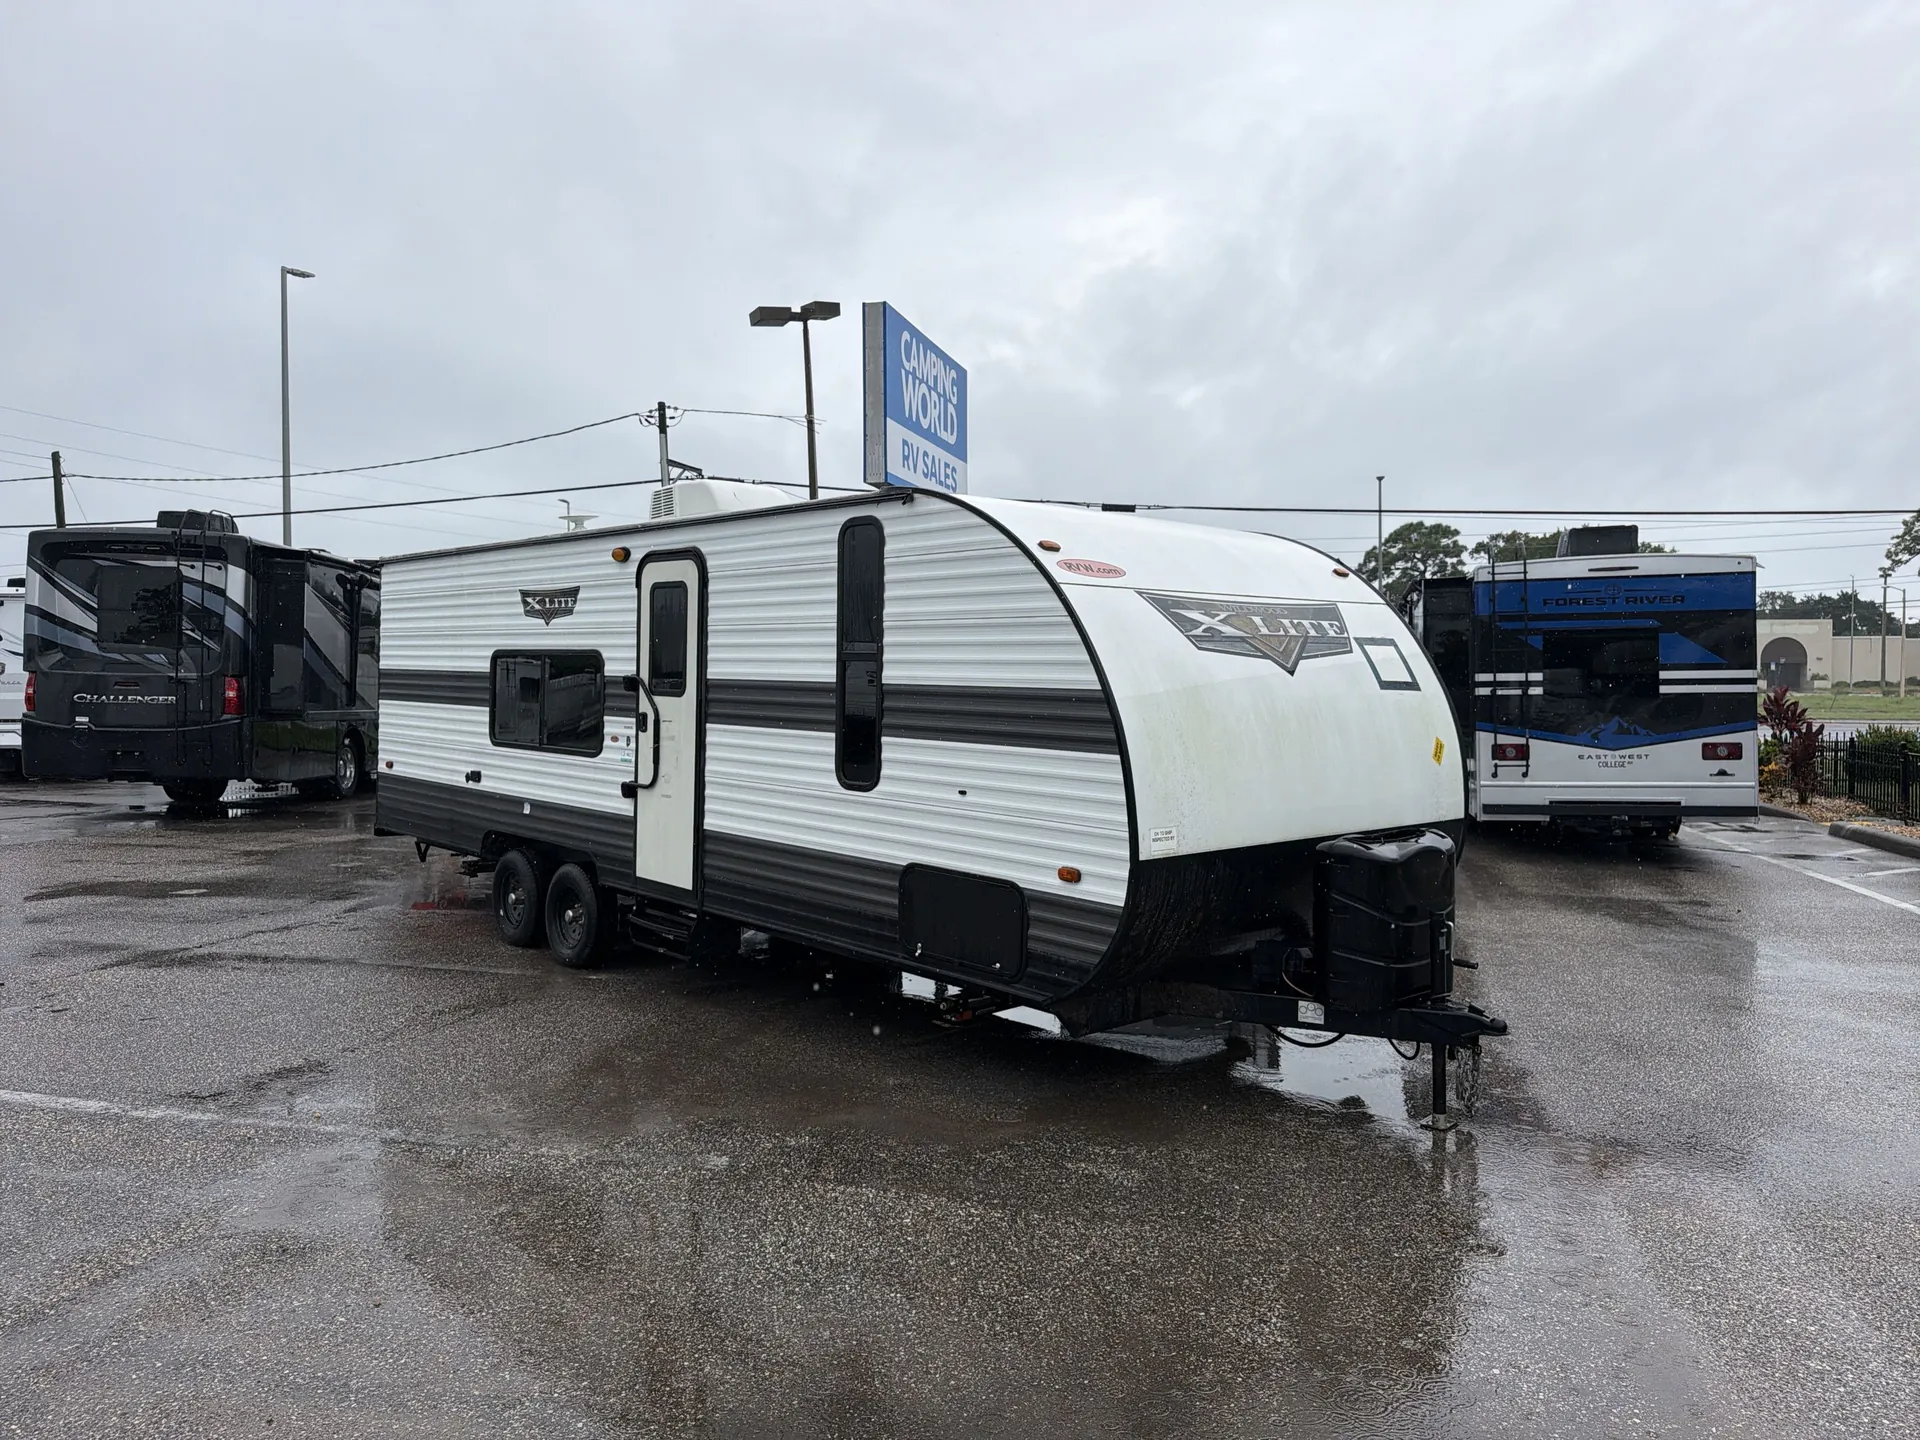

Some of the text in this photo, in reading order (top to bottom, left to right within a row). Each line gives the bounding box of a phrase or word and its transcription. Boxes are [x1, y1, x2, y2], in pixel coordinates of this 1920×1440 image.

[901, 330, 957, 405] CAMPING
[901, 368, 957, 445] WORLD
[902, 437, 957, 493] RV SALES
[524, 596, 576, 610] X LITE
[1542, 594, 1686, 607] FOREST RIVER
[1219, 603, 1288, 615] WILDWOOD
[1170, 609, 1349, 638] X LITE
[73, 693, 177, 704] CHALLENGER
[1597, 760, 1627, 768] COLLEGE
